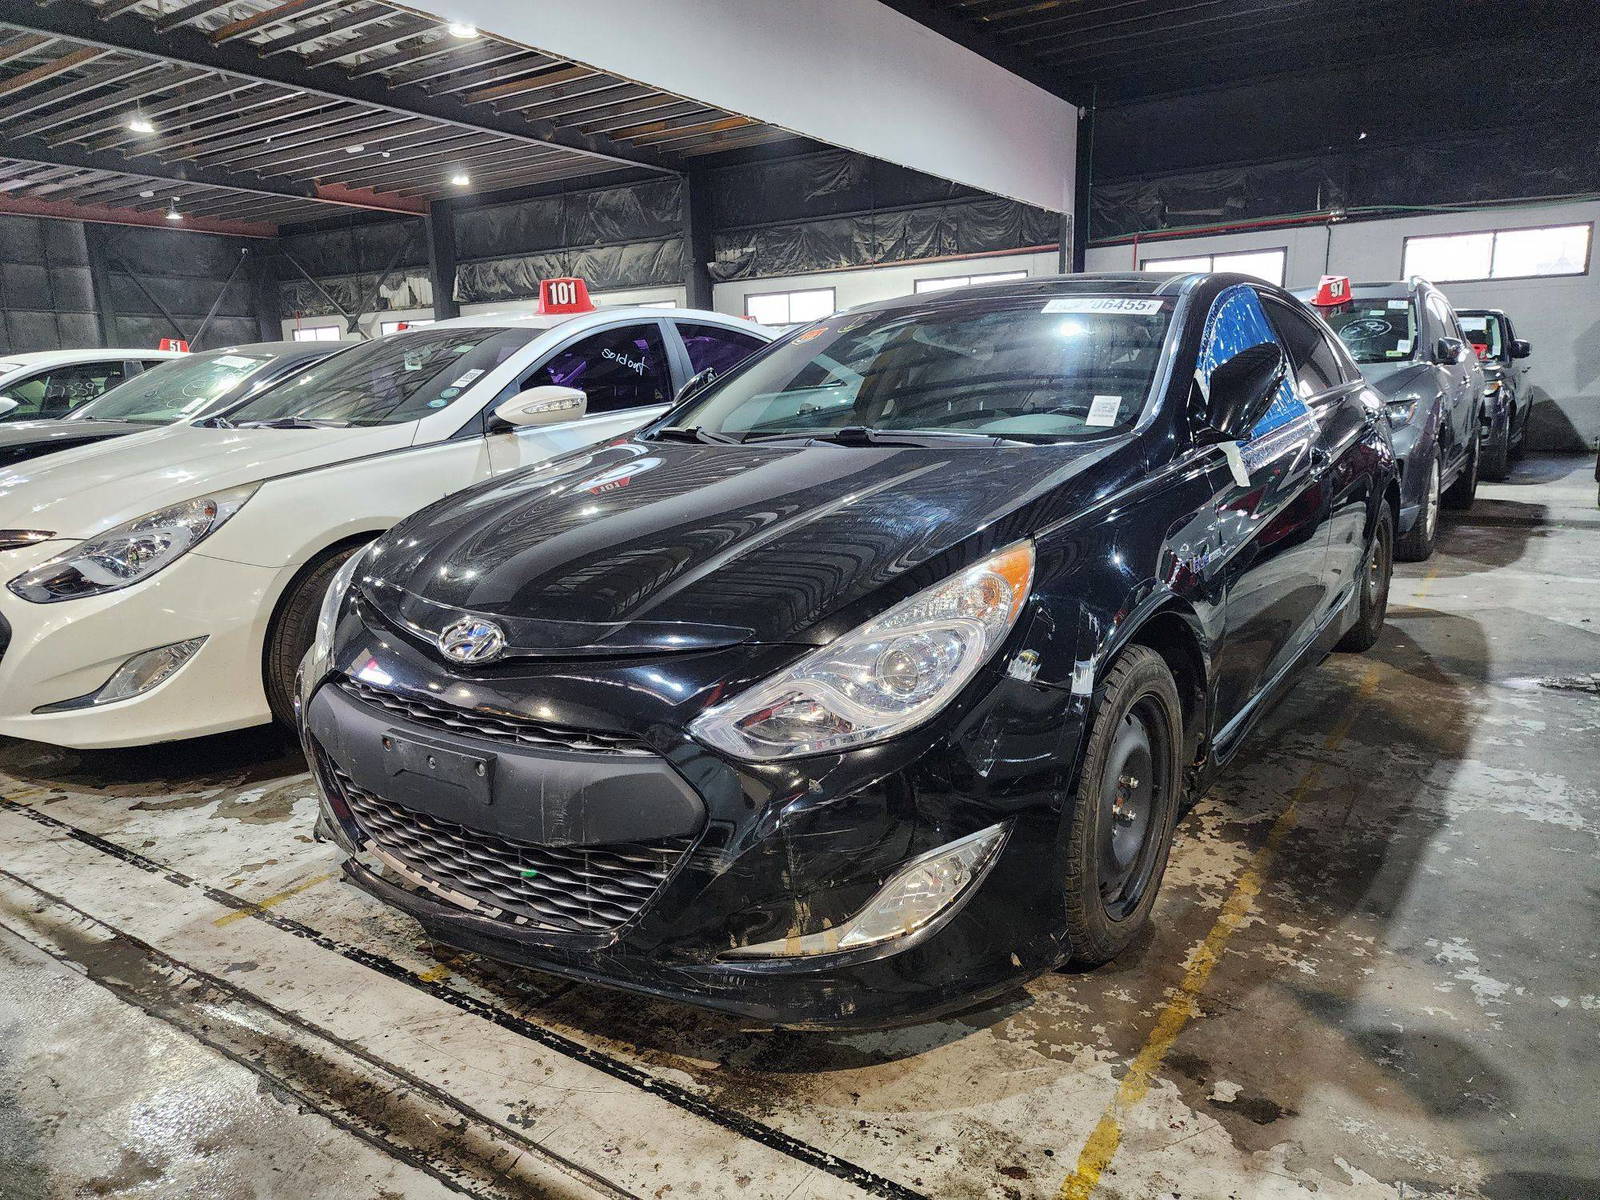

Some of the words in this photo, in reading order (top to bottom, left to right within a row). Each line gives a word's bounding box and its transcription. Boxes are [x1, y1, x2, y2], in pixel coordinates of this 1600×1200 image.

[549, 281, 577, 305] 101
[1330, 280, 1344, 298] 97
[169, 340, 181, 352] 51
